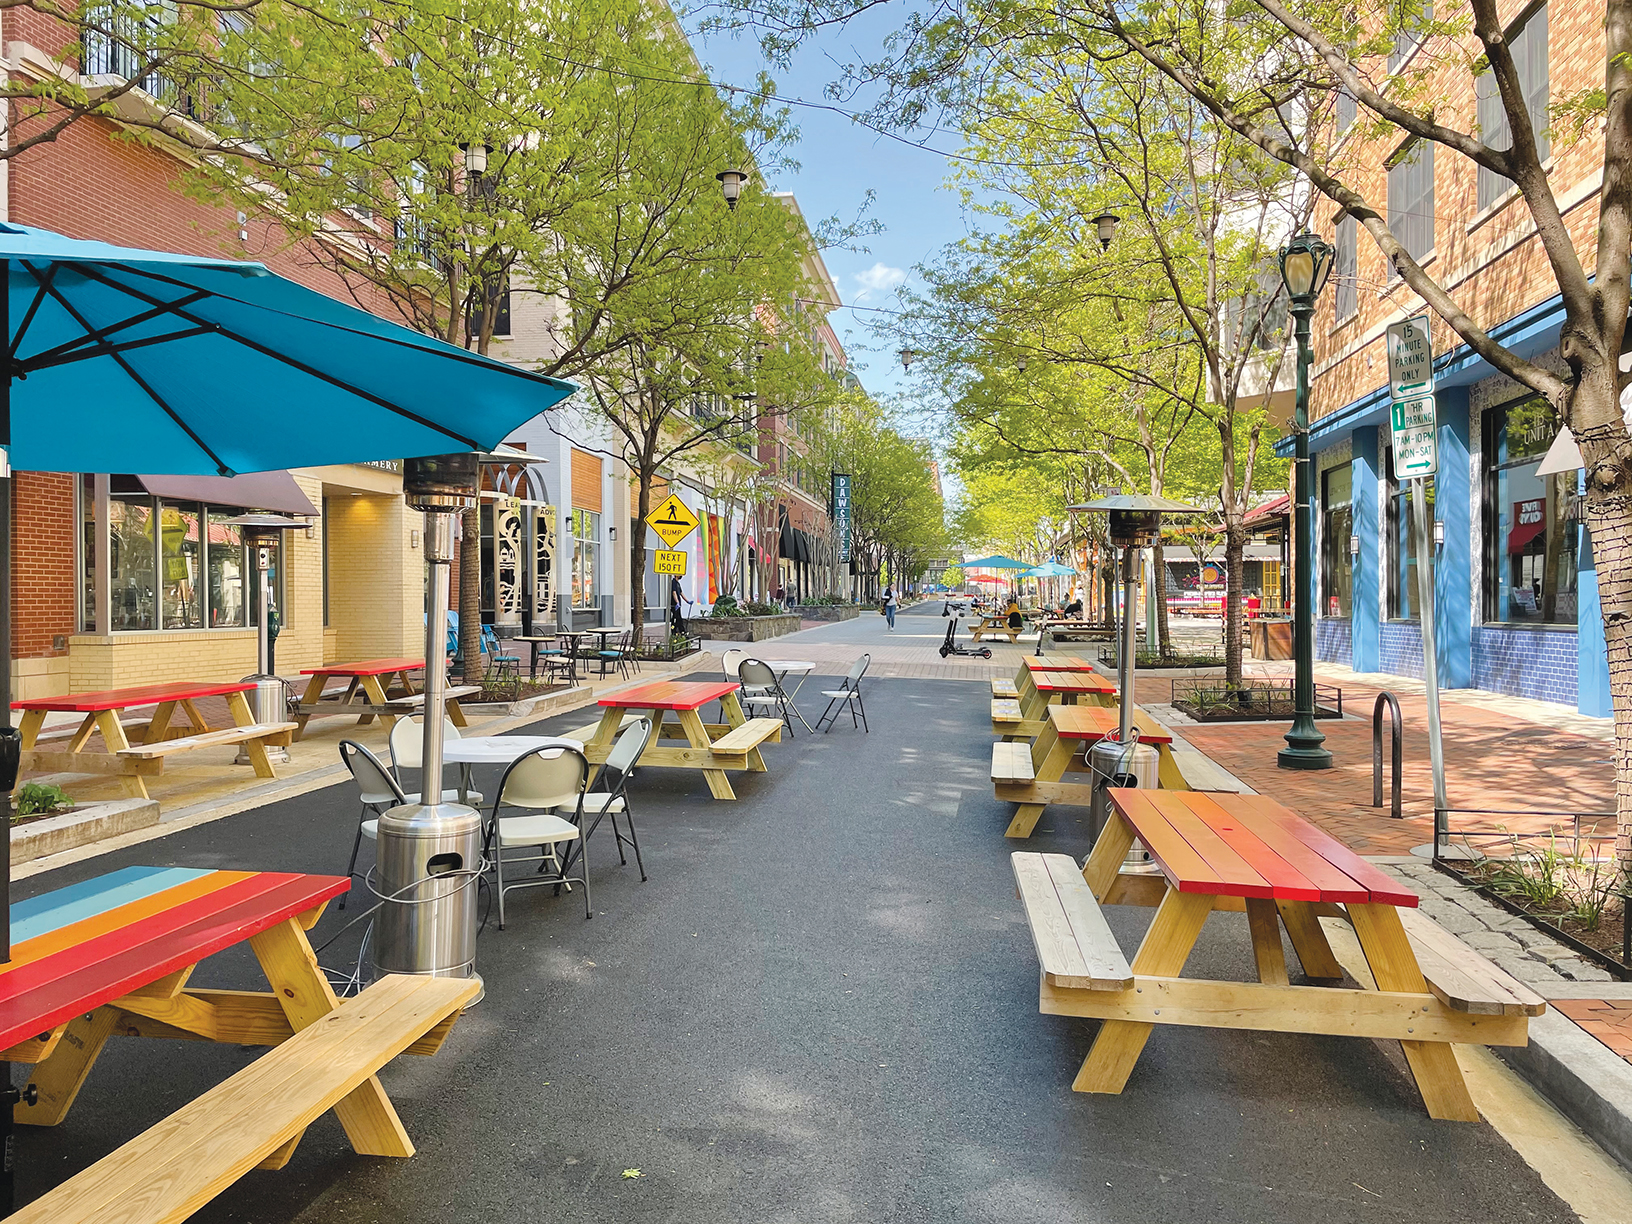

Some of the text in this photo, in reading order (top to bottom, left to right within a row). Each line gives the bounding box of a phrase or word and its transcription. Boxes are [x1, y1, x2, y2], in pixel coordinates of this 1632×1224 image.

[1403, 324, 1413, 339] 15
[1396, 339, 1421, 353] MINUTE
[1395, 352, 1425, 368] PARKING
[1401, 368, 1419, 381] ONLY
[1395, 407, 1401, 427] 1
[1406, 412, 1432, 426] PARKING
[1524, 425, 1545, 445] UNIT
[661, 528, 682, 537] BUMP
[660, 553, 681, 562] NEXT
[659, 563, 682, 572] 150 FT
